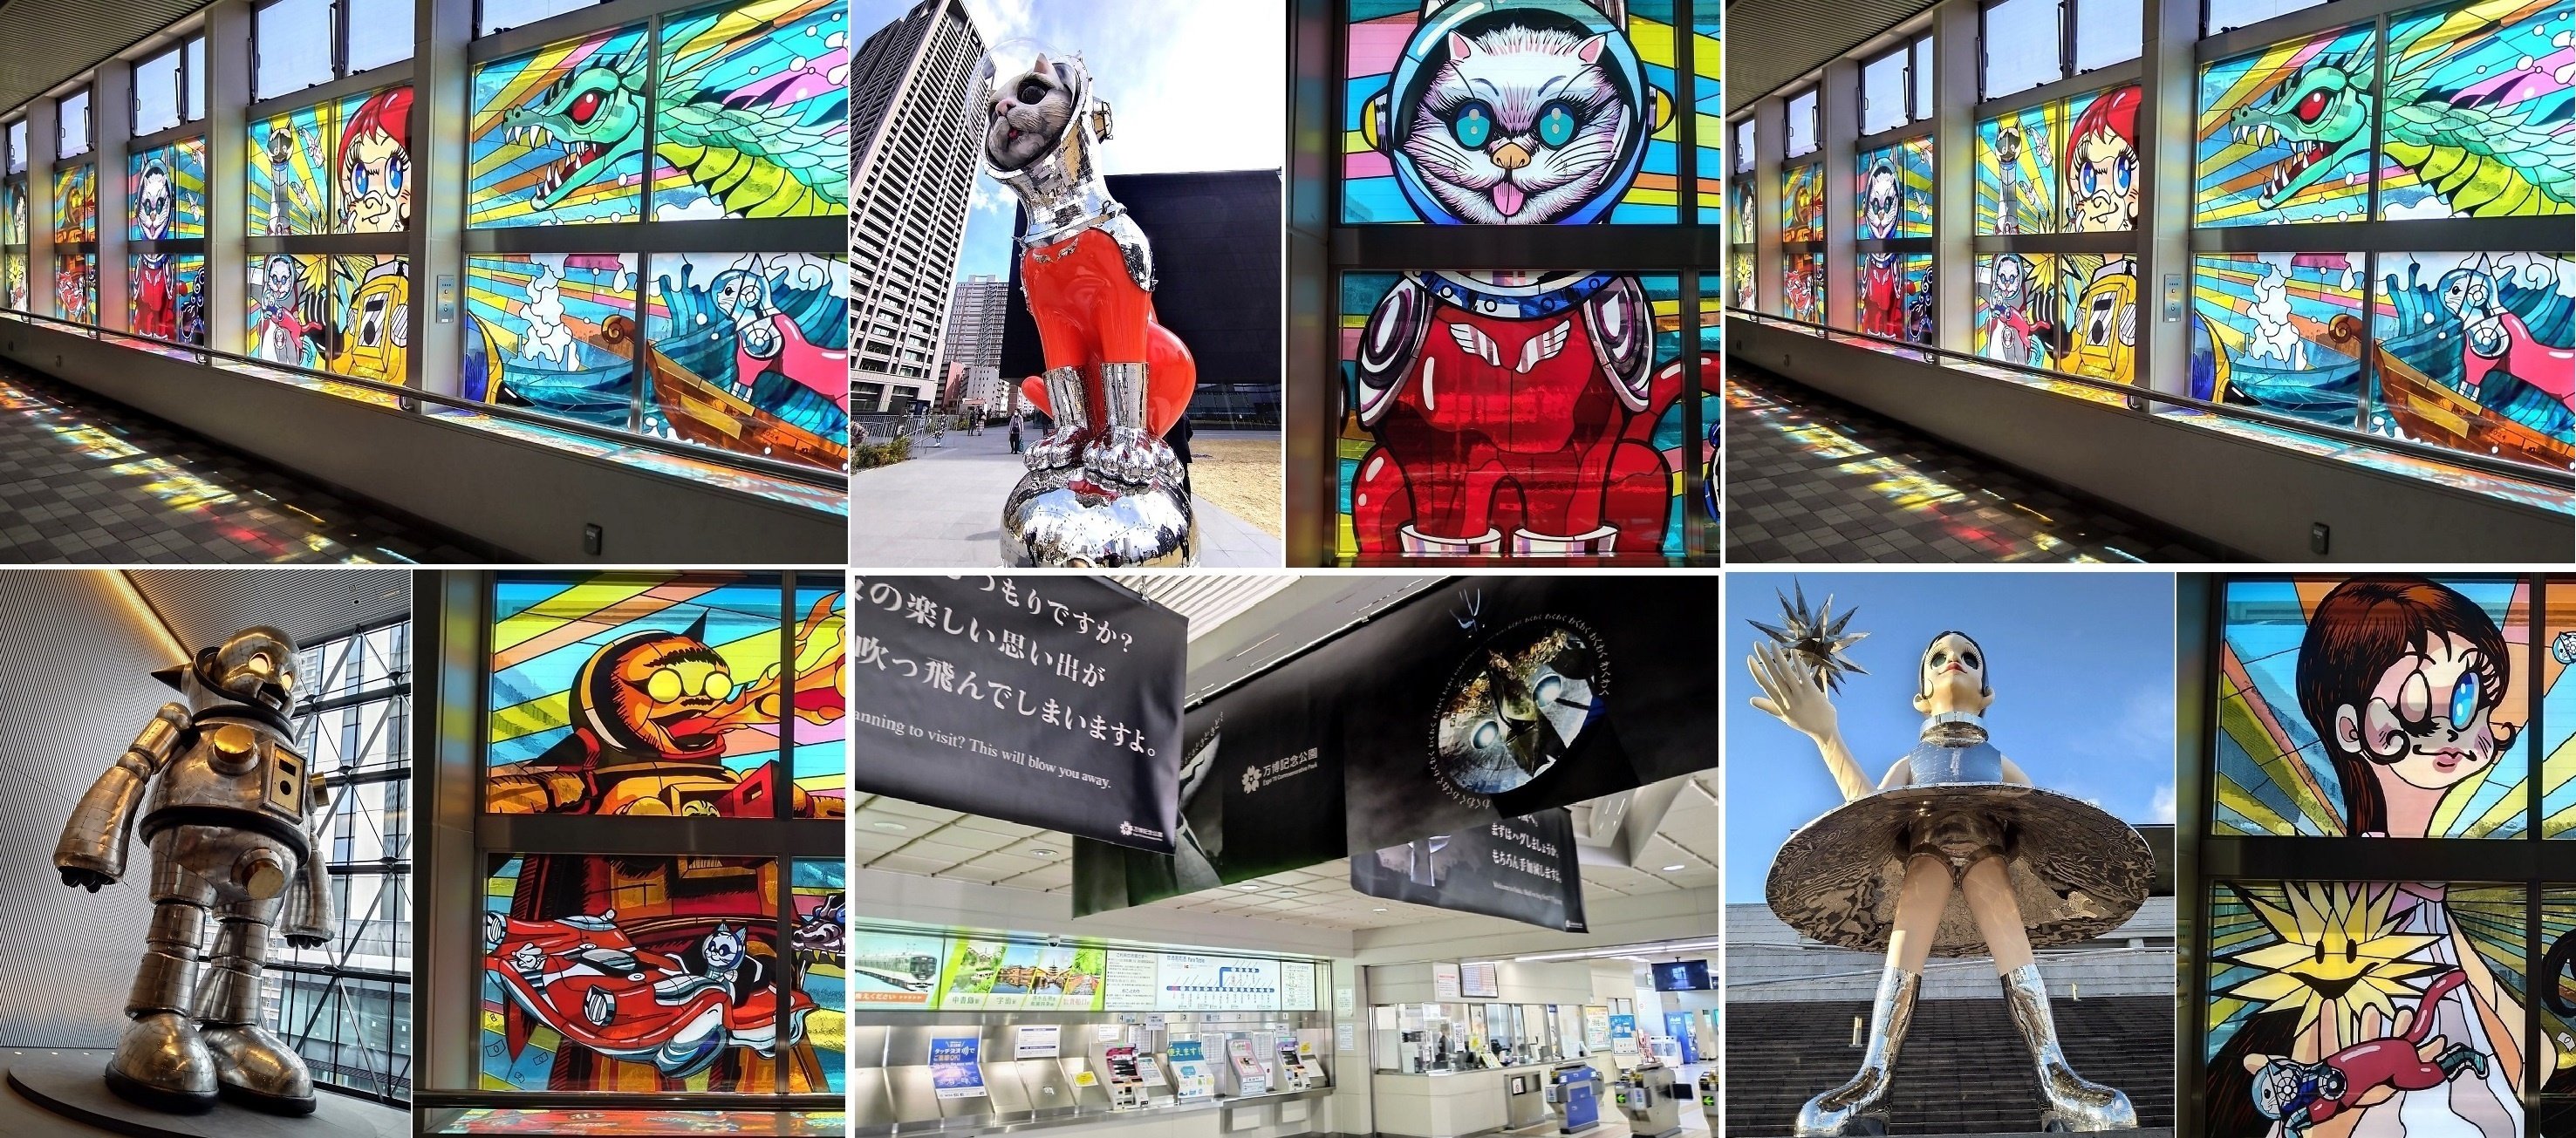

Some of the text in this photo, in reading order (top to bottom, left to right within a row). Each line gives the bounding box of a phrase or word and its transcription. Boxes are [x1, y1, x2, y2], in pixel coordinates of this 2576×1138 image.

[949, 576, 1133, 652] つもりですか?
[909, 724, 924, 739] to
[928, 729, 966, 749] visit?
[969, 738, 998, 758] This
[1002, 750, 1025, 766] will
[1028, 755, 1056, 774] blow
[1059, 767, 1080, 780] you
[1082, 773, 1111, 788] away.
[1262, 747, 1318, 777] 万博記念公園
